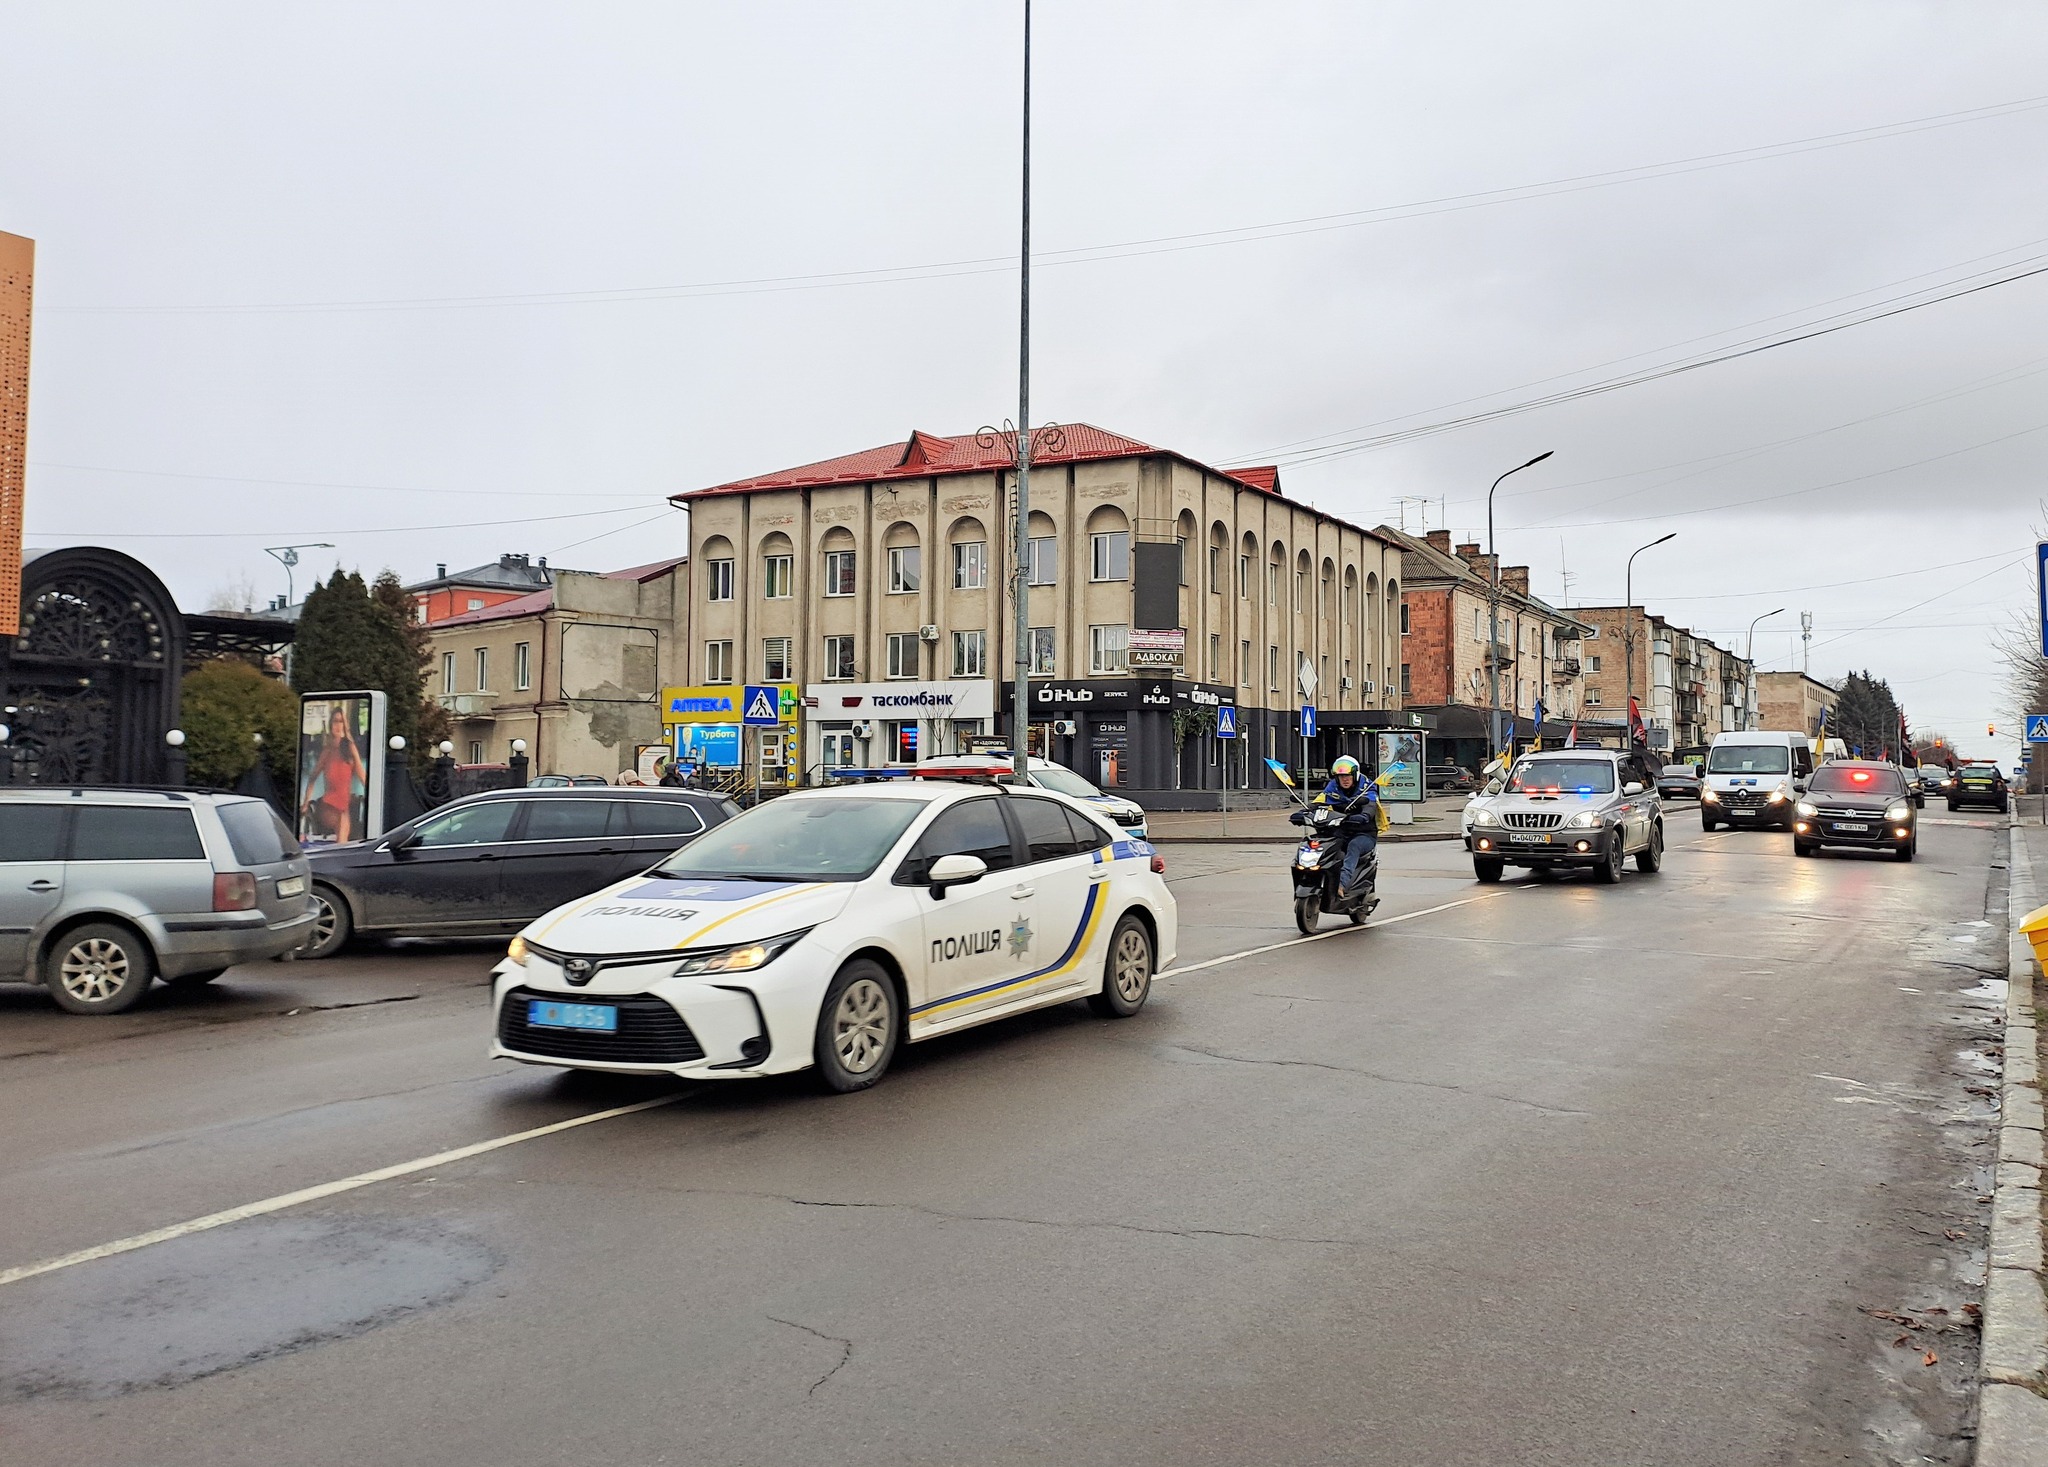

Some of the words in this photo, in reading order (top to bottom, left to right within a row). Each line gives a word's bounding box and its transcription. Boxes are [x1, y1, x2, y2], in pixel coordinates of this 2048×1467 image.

[1136, 653, 1178, 662] АДВОКАТ
[872, 691, 953, 706] таскомбанк
[1054, 689, 1094, 702] iHub
[1143, 695, 1170, 704] iHub
[670, 697, 732, 712] АПТЕКА
[700, 730, 736, 740] Турбота
[580, 906, 700, 921] ПОЛІЦІЯ
[931, 929, 1001, 963] ПОЛІЦІЯ
